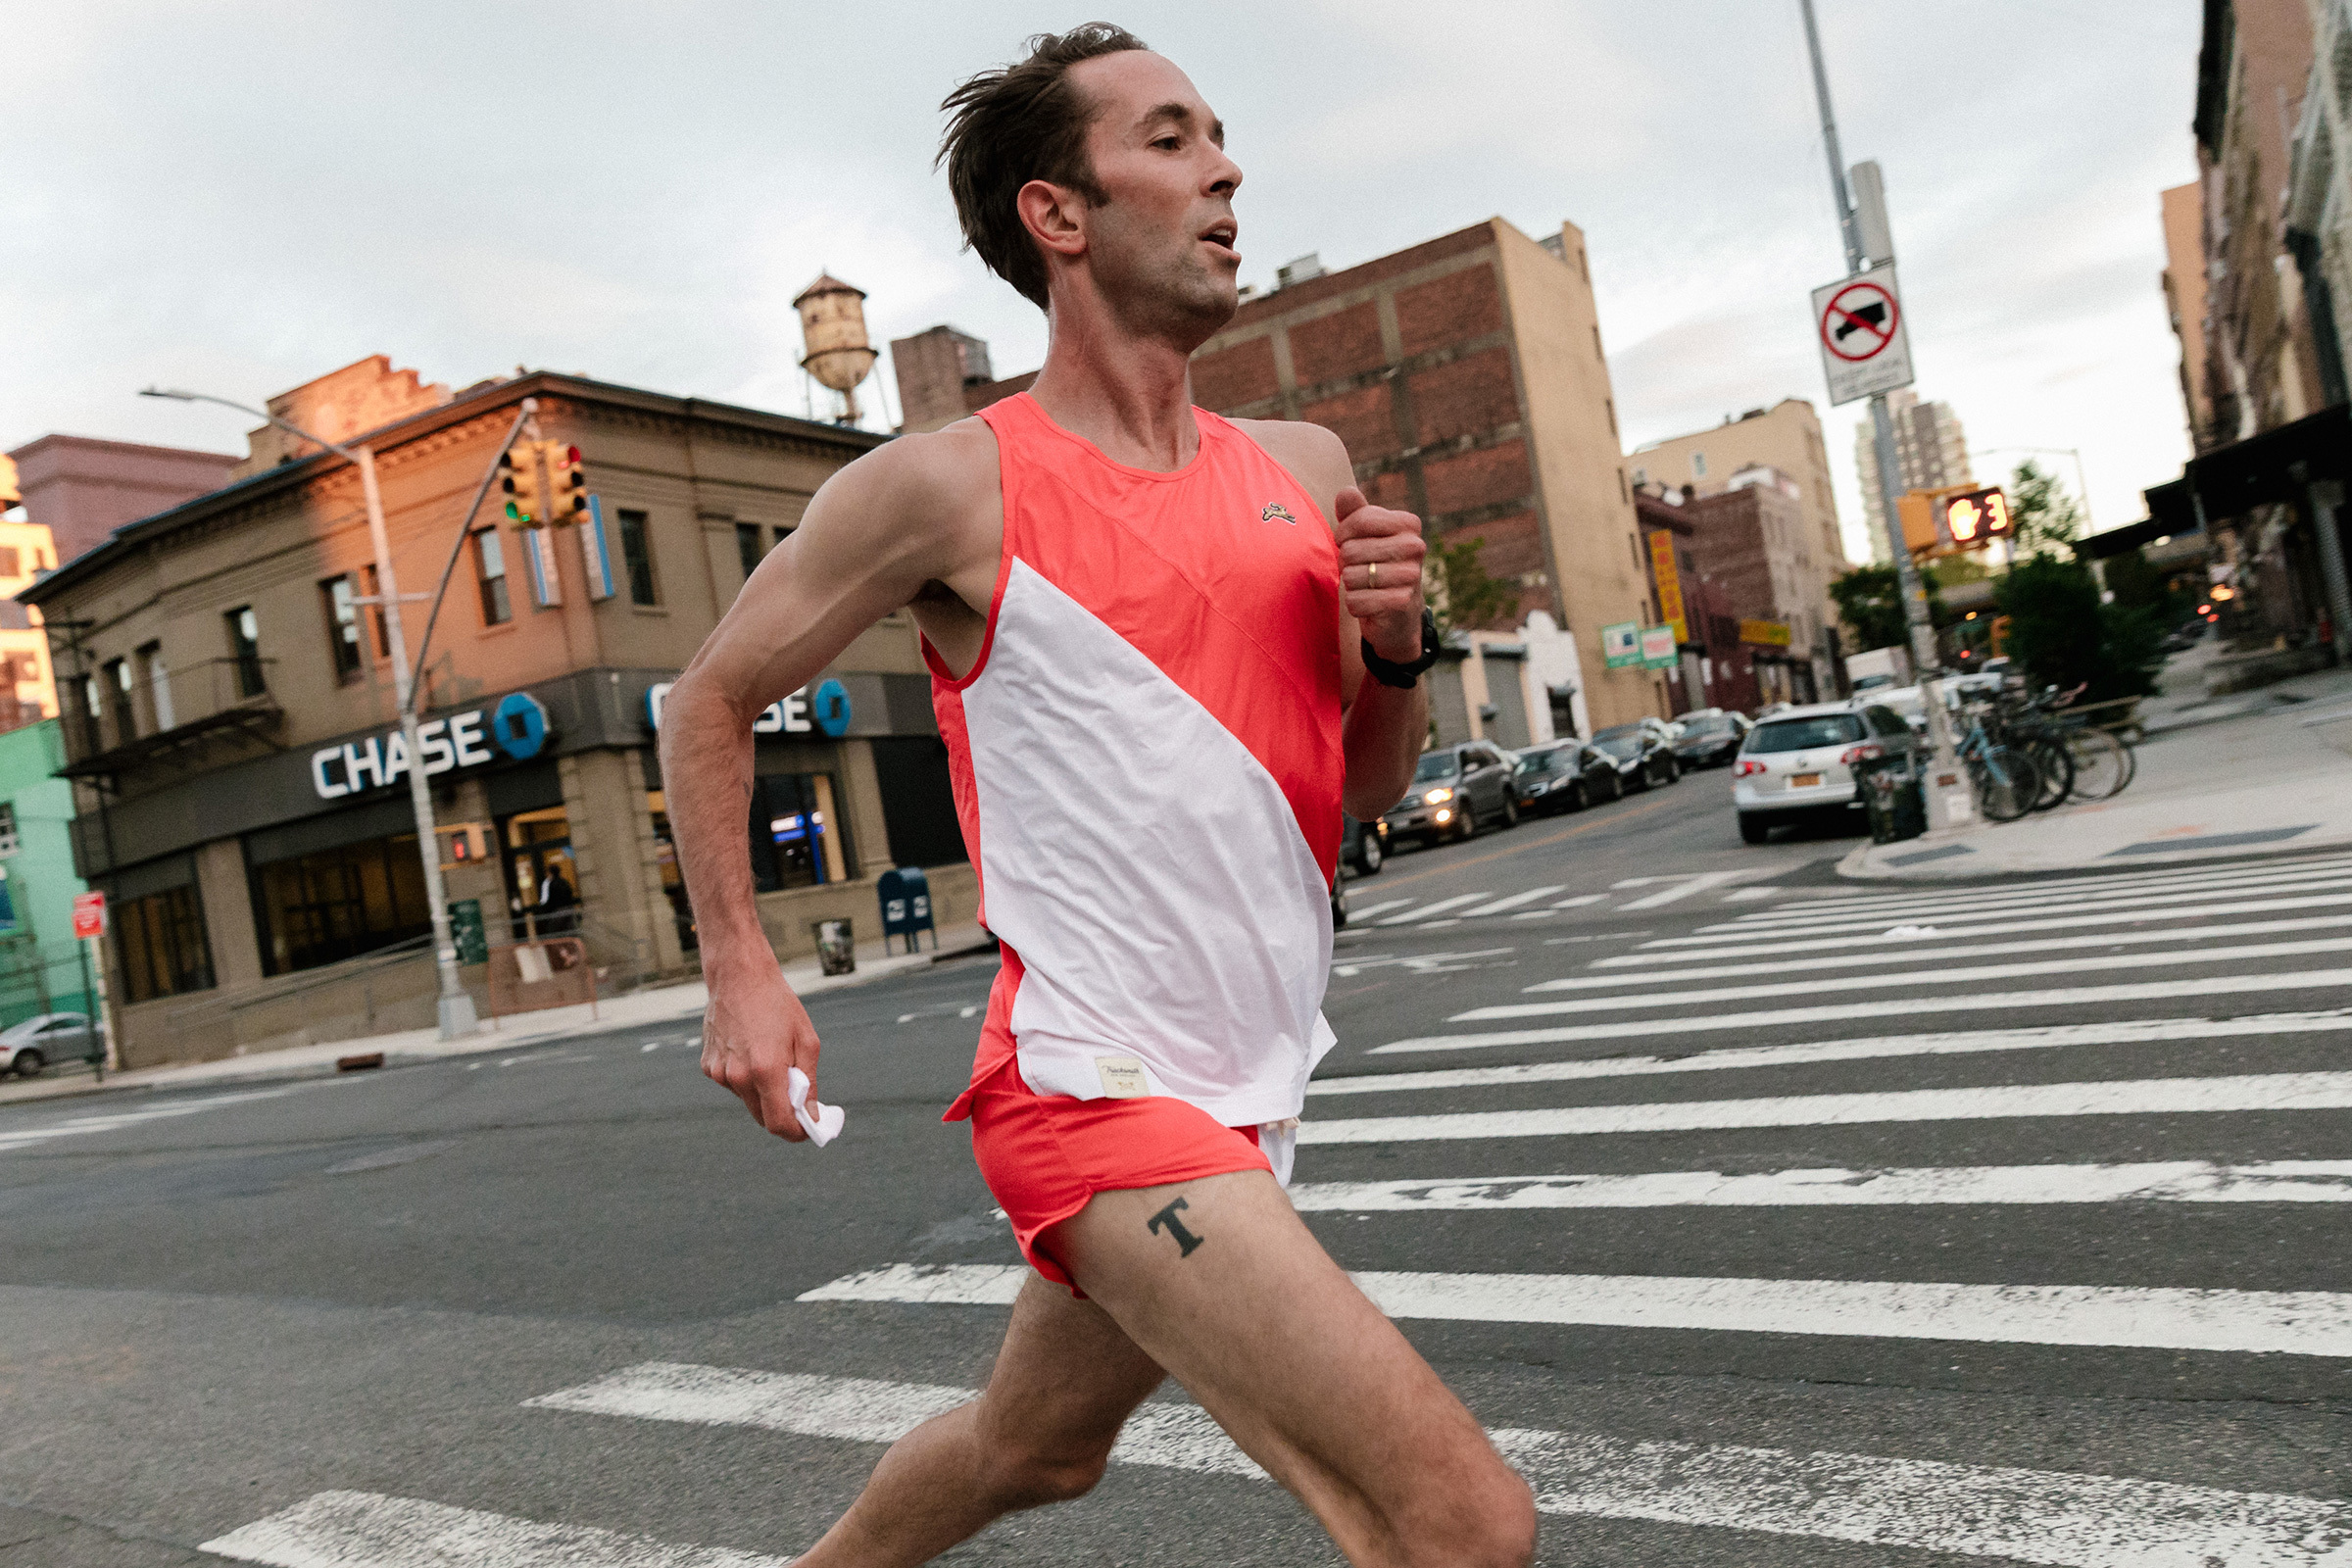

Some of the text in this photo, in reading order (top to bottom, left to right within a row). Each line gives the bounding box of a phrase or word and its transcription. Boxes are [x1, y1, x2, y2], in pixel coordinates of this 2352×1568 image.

[1984, 493, 2008, 530] 3
[311, 710, 492, 800] CHASE
[1148, 1197, 1204, 1258] T
